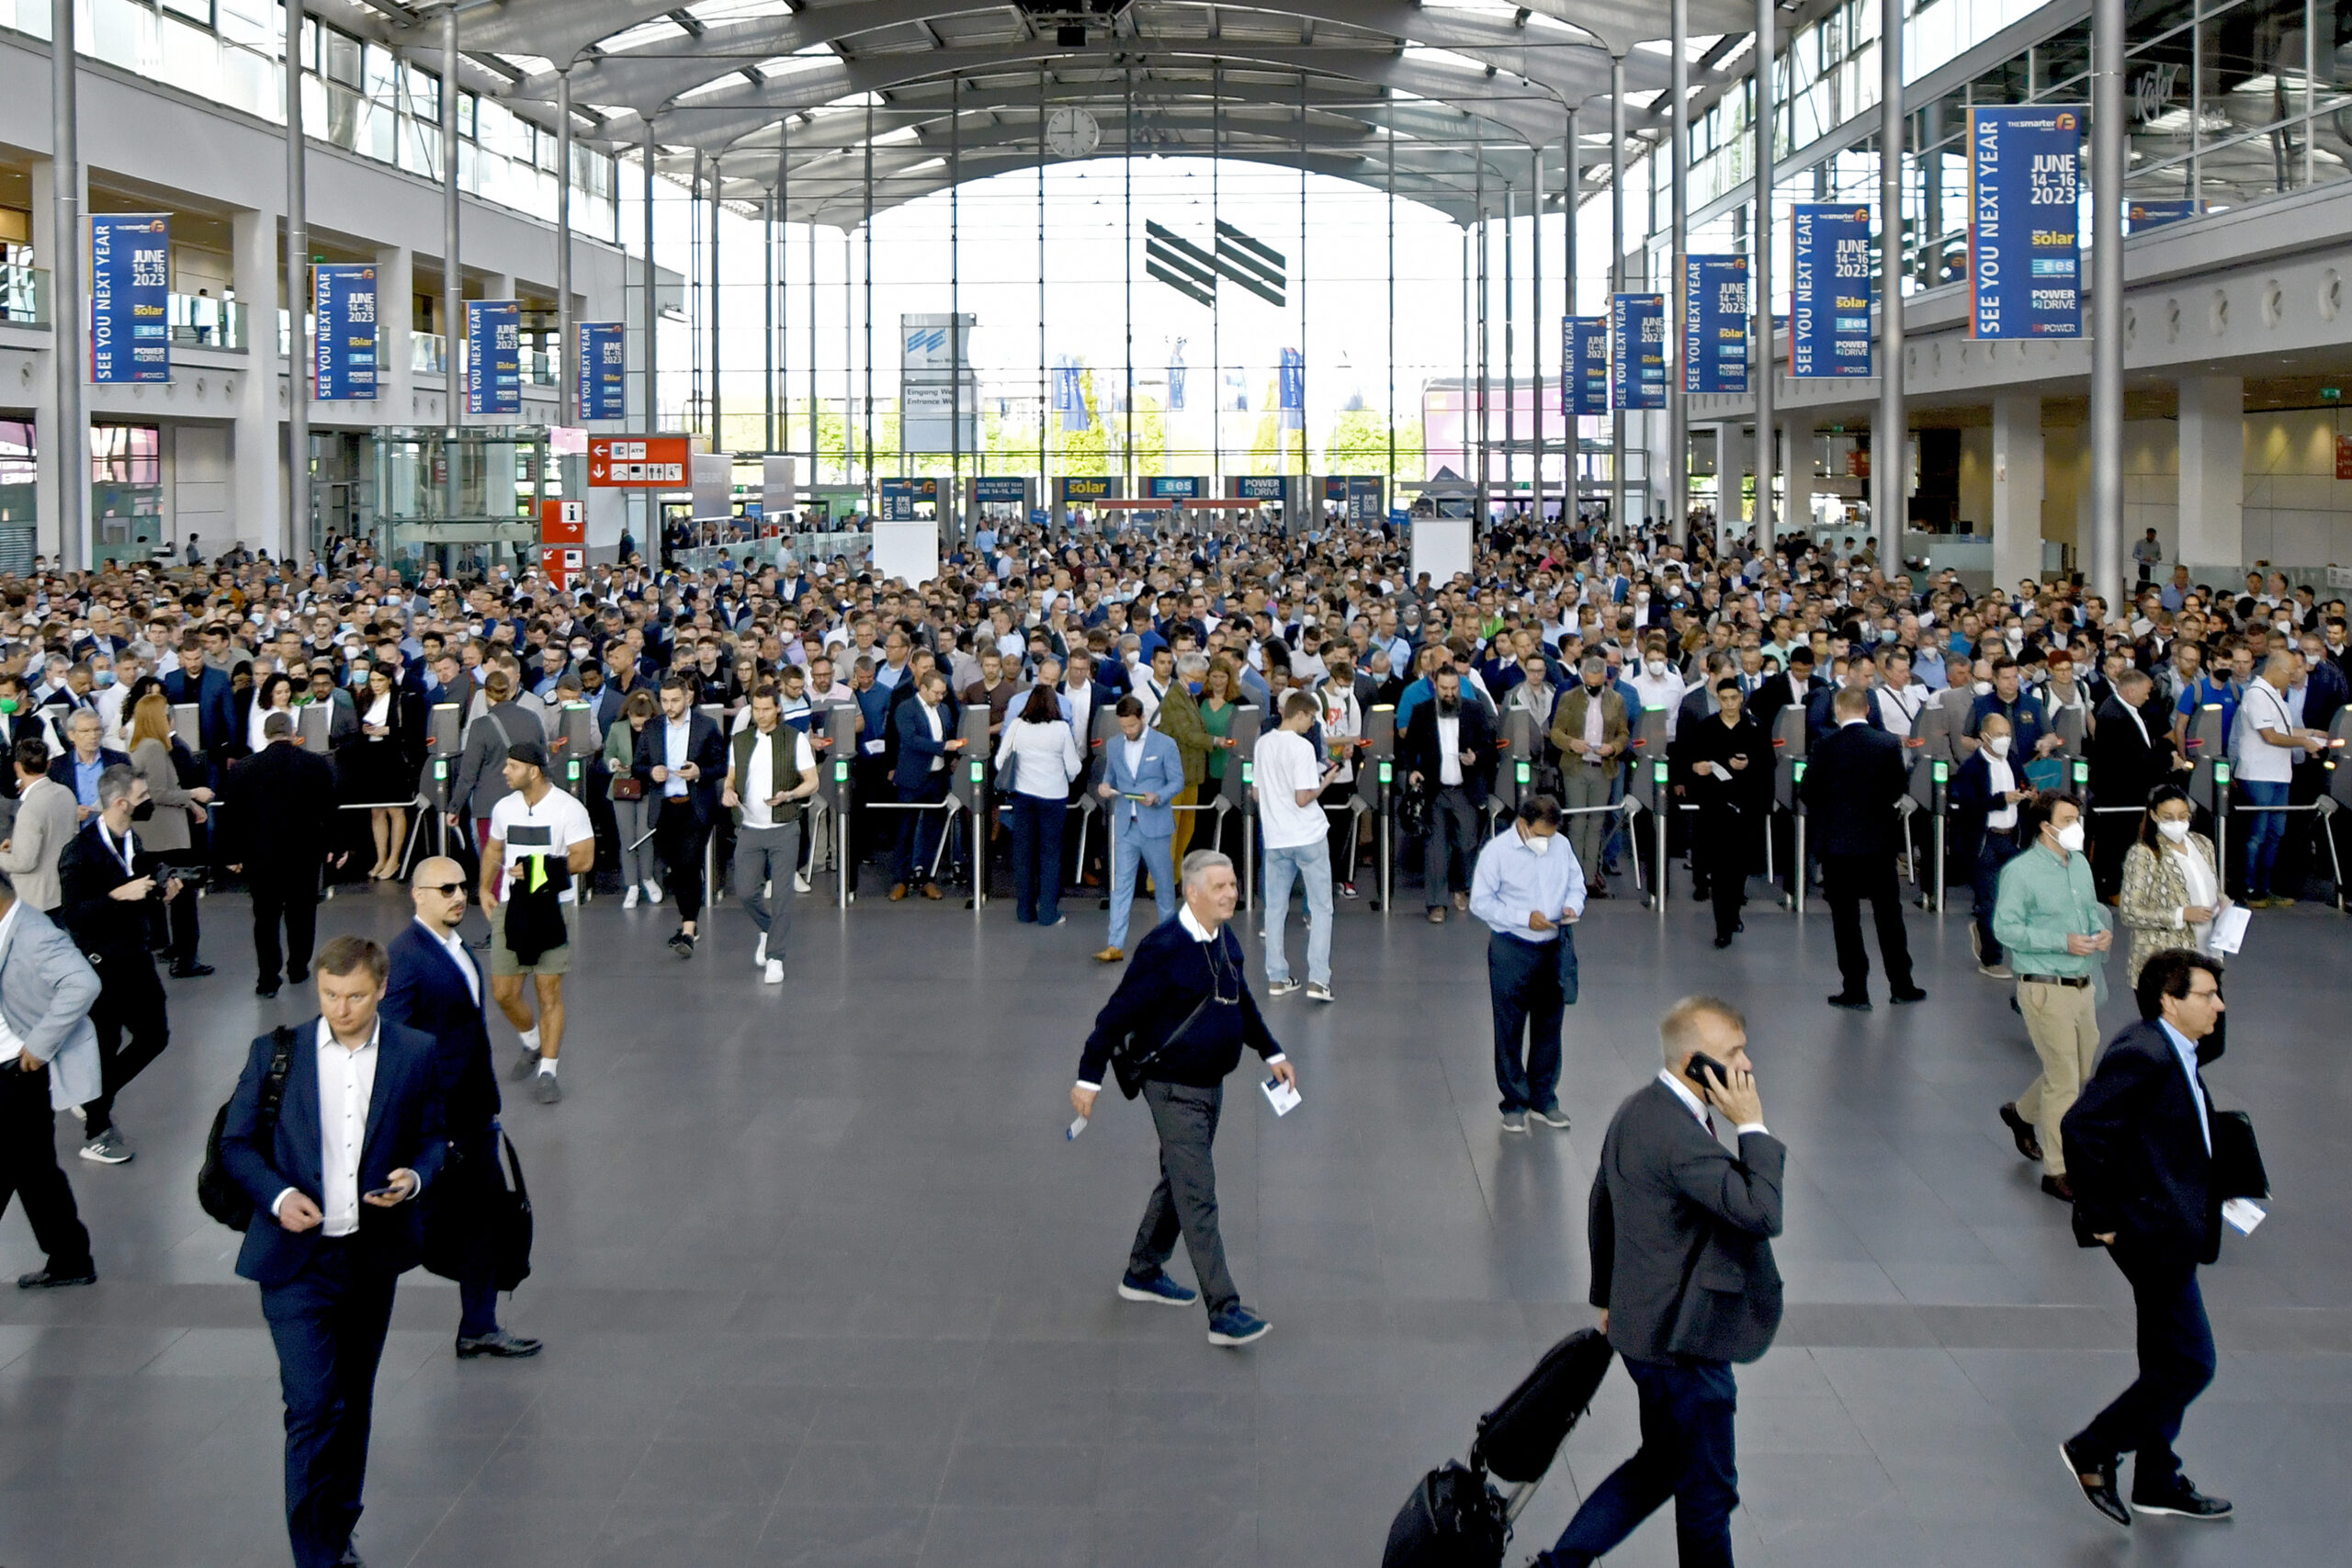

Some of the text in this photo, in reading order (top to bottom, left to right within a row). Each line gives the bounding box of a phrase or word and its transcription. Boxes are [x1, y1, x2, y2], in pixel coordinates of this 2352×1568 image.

[2031, 154, 2075, 173] JUNE
[2031, 187, 2075, 204] 2023
[1980, 121, 1999, 333] SEE YOU NEXT YEAR
[2032, 231, 2075, 244] solar
[1836, 240, 1868, 253] JUNE
[132, 250, 165, 263] JUNE
[1836, 265, 1868, 277] 2023
[2044, 261, 2075, 272] ees
[132, 274, 165, 286] 2023
[1719, 283, 1746, 294] JUNE
[1798, 214, 1812, 373] SEE YOU NEXT YEAR
[2032, 290, 2075, 299] POWER
[96, 225, 111, 378] SEE YOU NEXT YEAR
[348, 293, 374, 303] JUNE
[1836, 297, 1867, 308] solar
[134, 306, 164, 316] solar
[1719, 303, 1746, 313] 2023
[348, 312, 374, 322] 2023
[1642, 317, 1664, 325] JUNE
[496, 325, 517, 333] JUNE
[1689, 263, 1700, 389] SEE YOU NEXT YEAR
[320, 274, 331, 397] SEE YOU NEXT YEAR
[1642, 333, 1664, 343] 2023
[1720, 329, 1744, 338] solar
[496, 341, 517, 349] 2023
[1616, 300, 1626, 406] SEE YOU NEXT YEAR
[471, 309, 481, 412] SEE YOU NEXT YEAR
[582, 382, 591, 399] YOU
[1566, 376, 1574, 394] YOU
[582, 402, 591, 417] SEE
[1566, 397, 1574, 412] SEE
[1069, 480, 1106, 493] solar
[1166, 480, 1192, 491] ees
[884, 496, 893, 520] DATE
[1351, 494, 1360, 518] DATE
